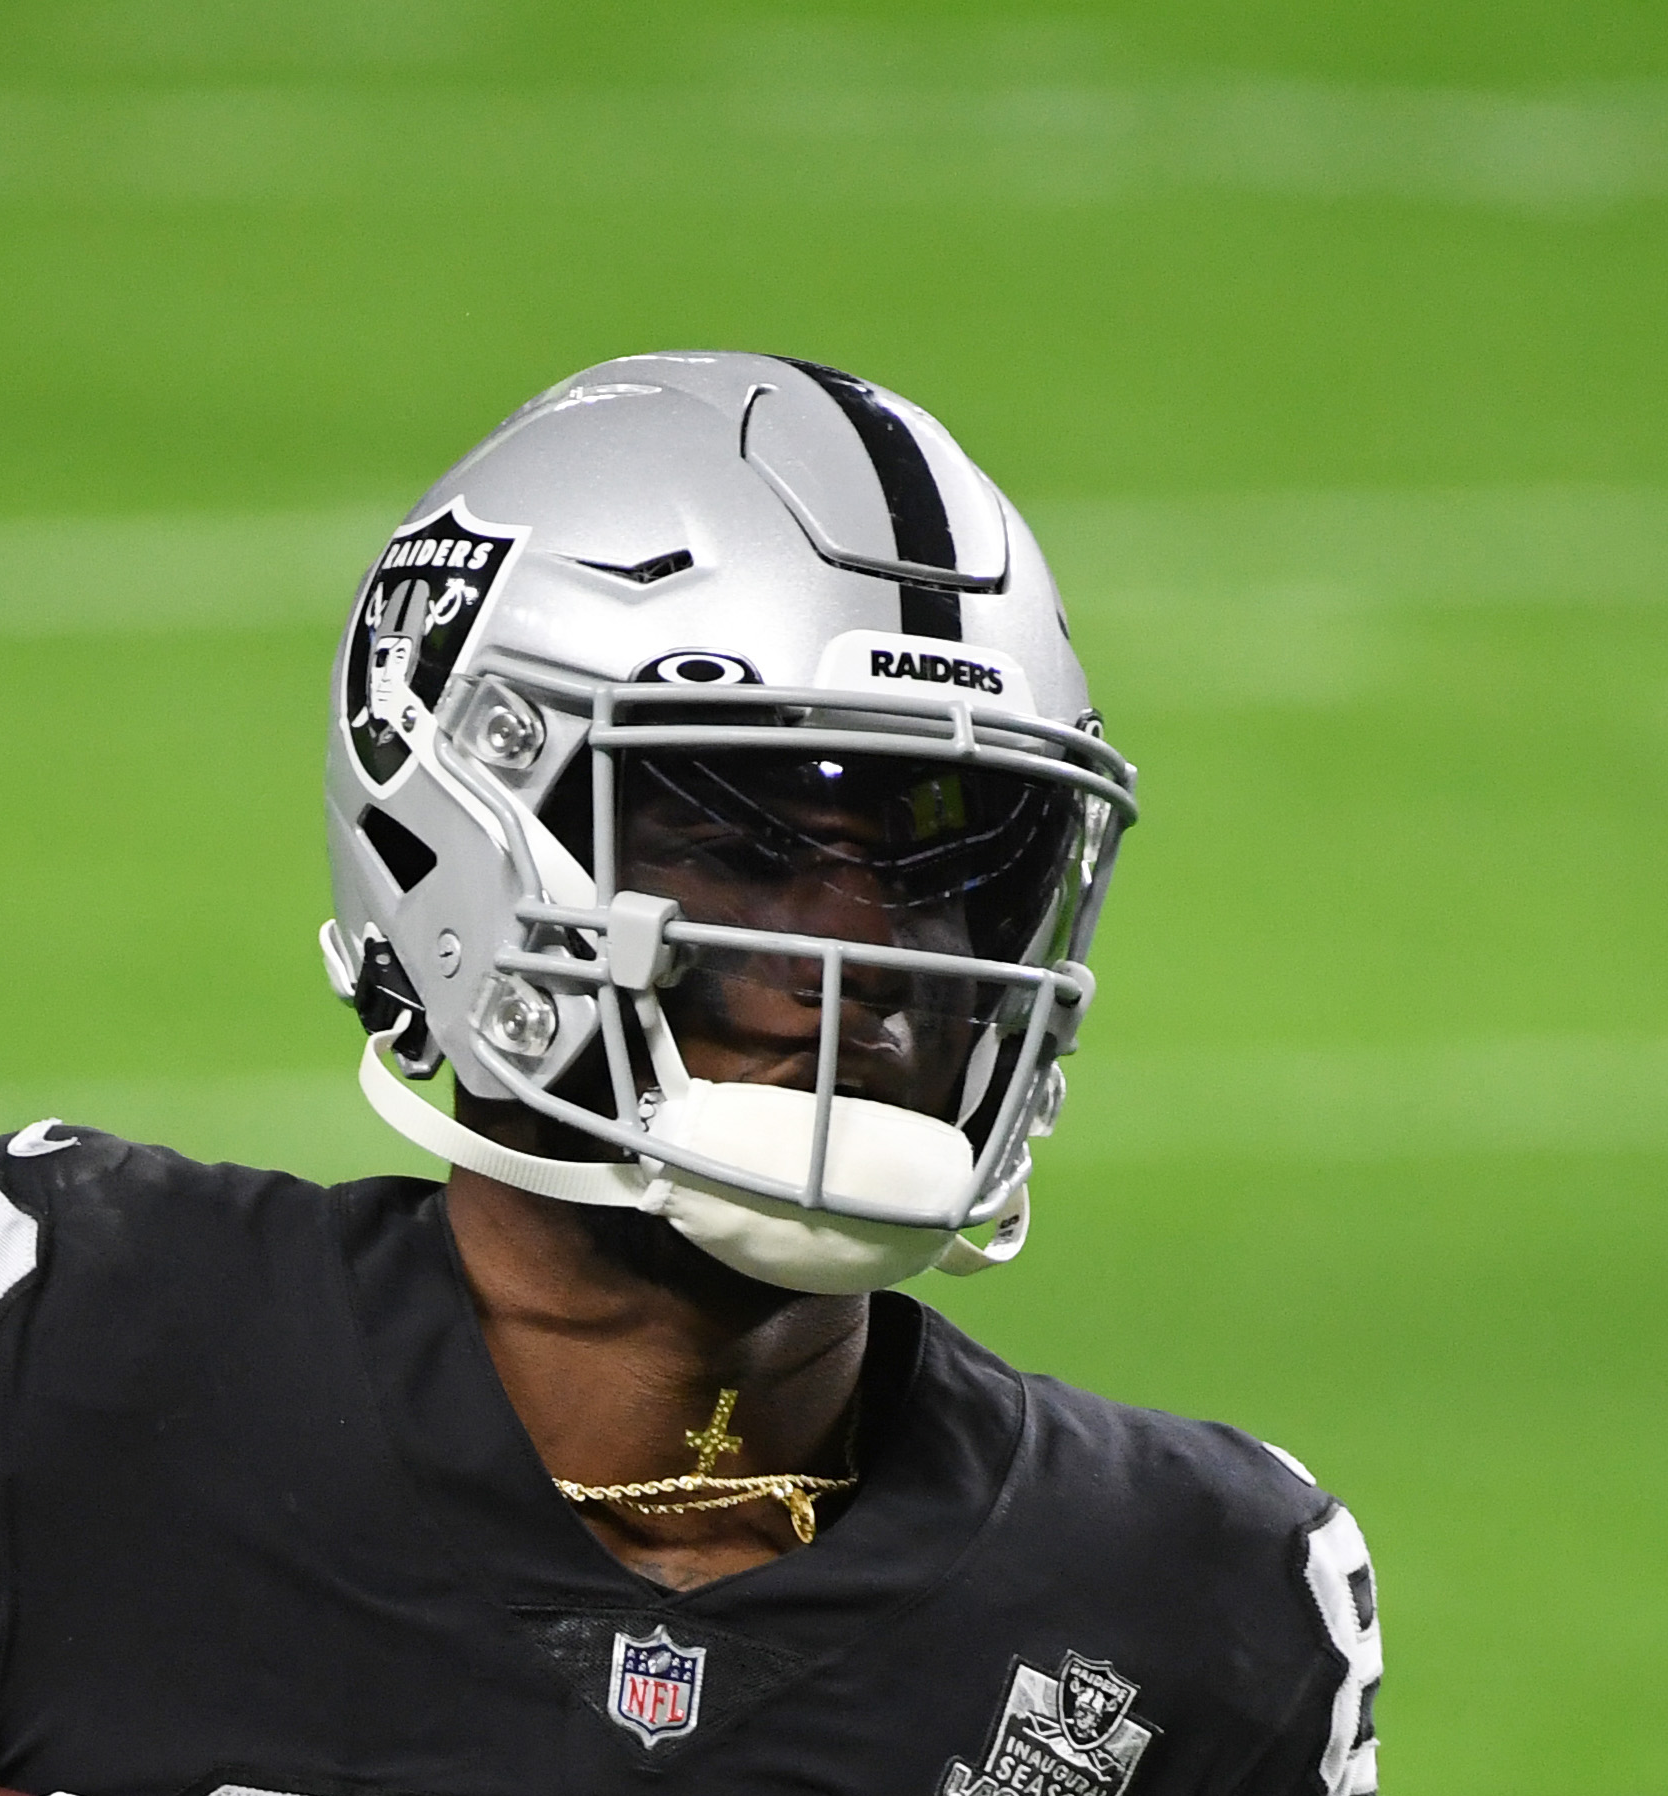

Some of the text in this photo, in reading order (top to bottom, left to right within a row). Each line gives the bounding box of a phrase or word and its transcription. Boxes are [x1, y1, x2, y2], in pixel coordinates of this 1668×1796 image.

[381, 538, 494, 570] RAIDERS
[870, 649, 1003, 695] RAIDERS
[626, 1675, 685, 1725] NFL
[1070, 1663, 1129, 1704] RAIDERS
